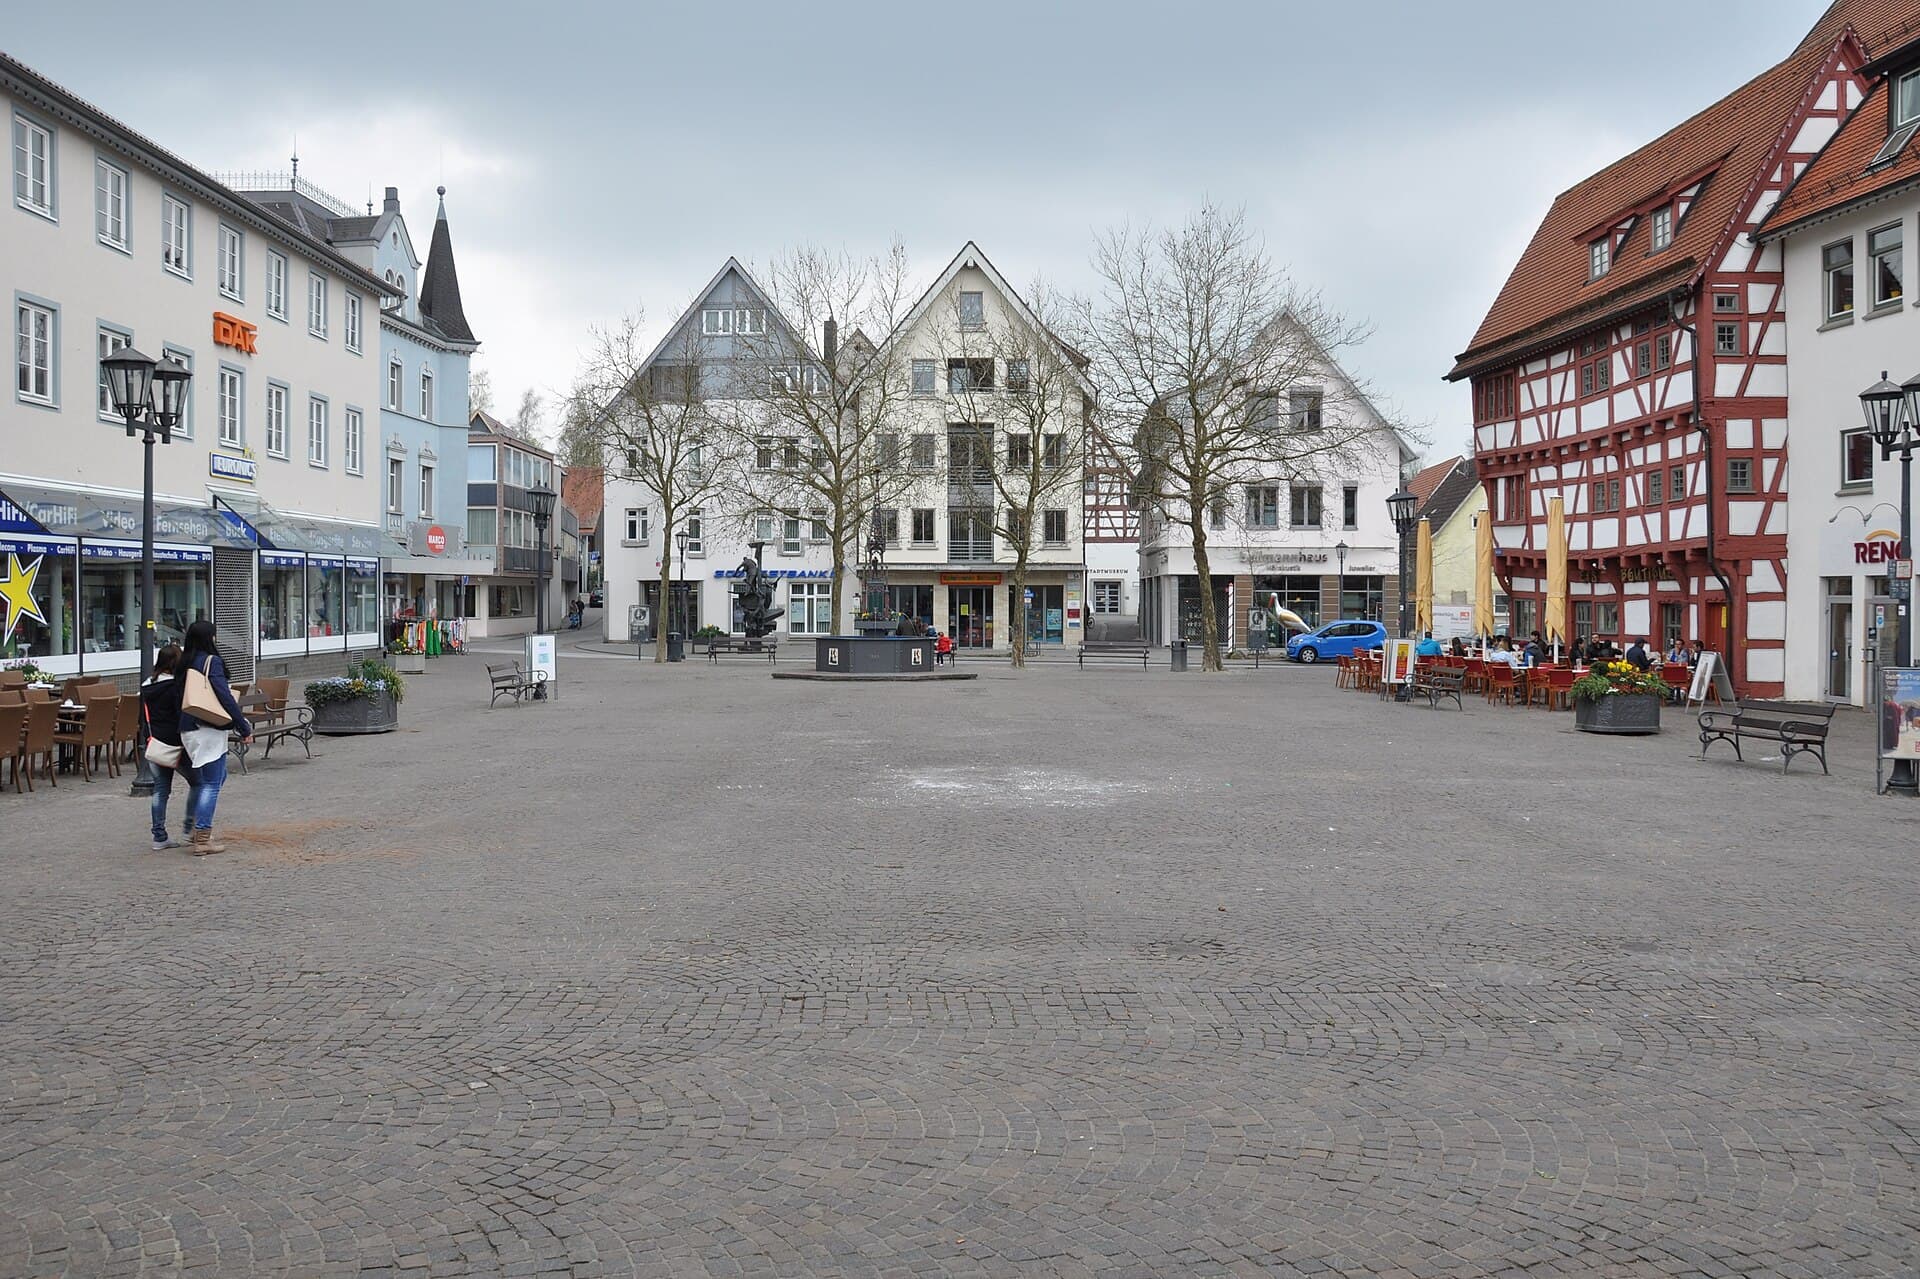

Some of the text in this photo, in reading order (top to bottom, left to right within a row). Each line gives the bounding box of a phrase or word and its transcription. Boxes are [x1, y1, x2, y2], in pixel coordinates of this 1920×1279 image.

[213, 317, 257, 354] DAK
[102, 510, 135, 530] Video
[155, 516, 208, 537] Fernsehen
[428, 535, 445, 545] MARCO
[27, 544, 47, 553] Plasma
[97, 548, 113, 557] Video
